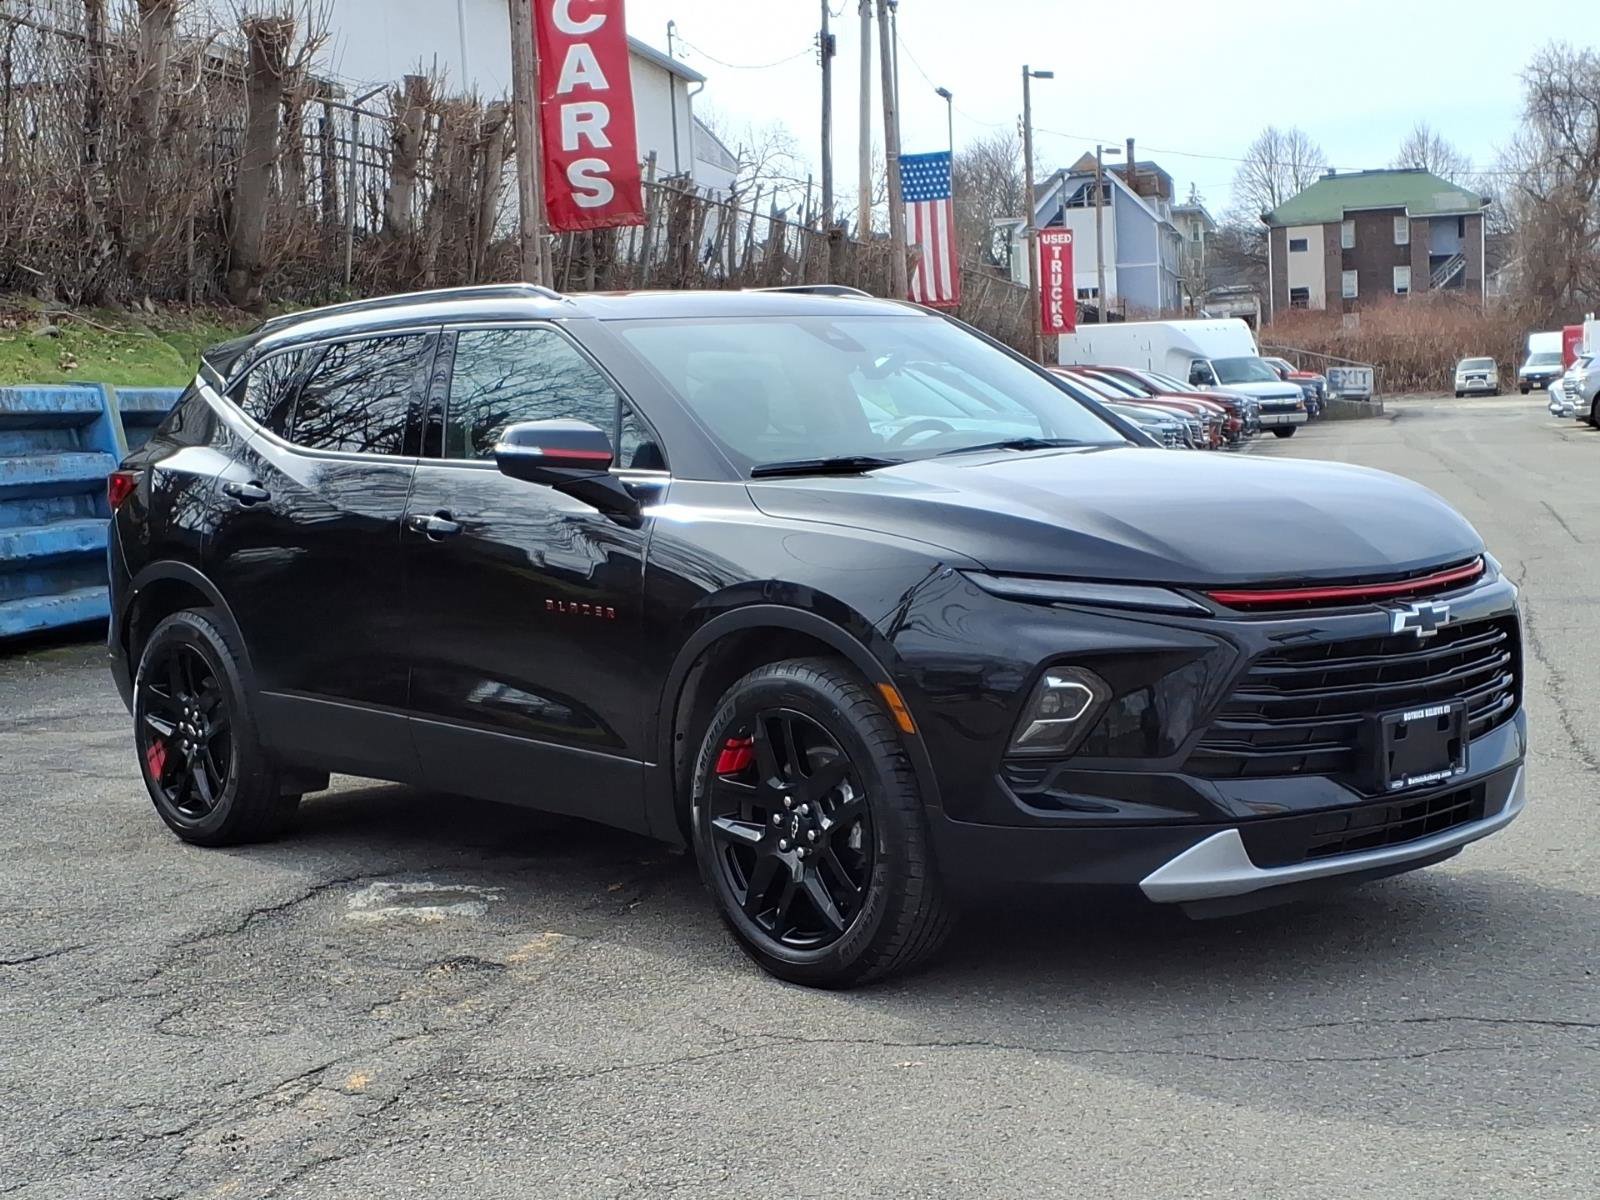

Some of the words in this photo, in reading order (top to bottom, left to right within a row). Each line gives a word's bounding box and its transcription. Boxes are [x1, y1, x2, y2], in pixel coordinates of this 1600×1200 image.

[552, 0, 614, 208] CARS
[1042, 234, 1072, 244] USED
[1051, 246, 1064, 327] TRUCKS
[1328, 370, 1368, 385] EXIT
[545, 599, 616, 618] BLAZER
